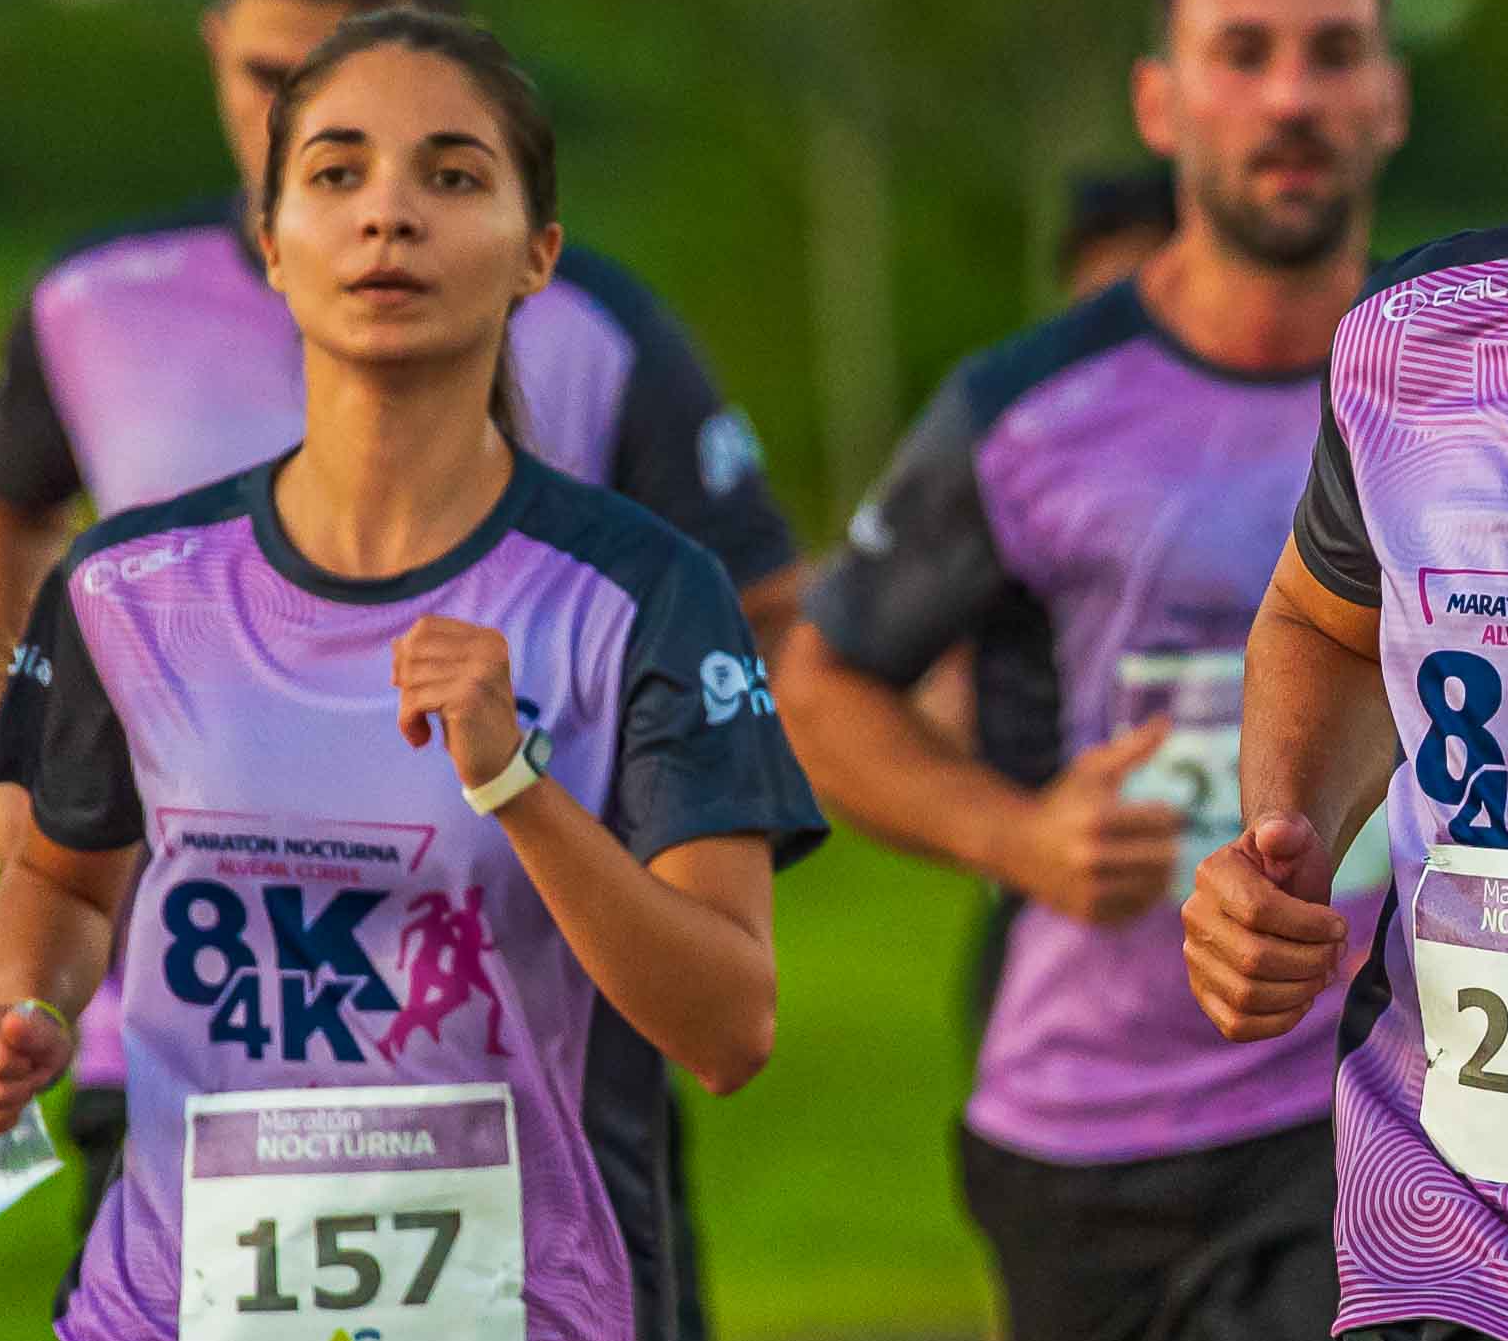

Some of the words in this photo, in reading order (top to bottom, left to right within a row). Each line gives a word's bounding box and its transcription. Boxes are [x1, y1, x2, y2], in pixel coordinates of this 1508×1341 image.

[162, 878, 402, 1012] 8K
[209, 974, 367, 1062] 4K
[257, 1130, 435, 1161] NOCTURNA
[237, 1209, 460, 1312] 157
